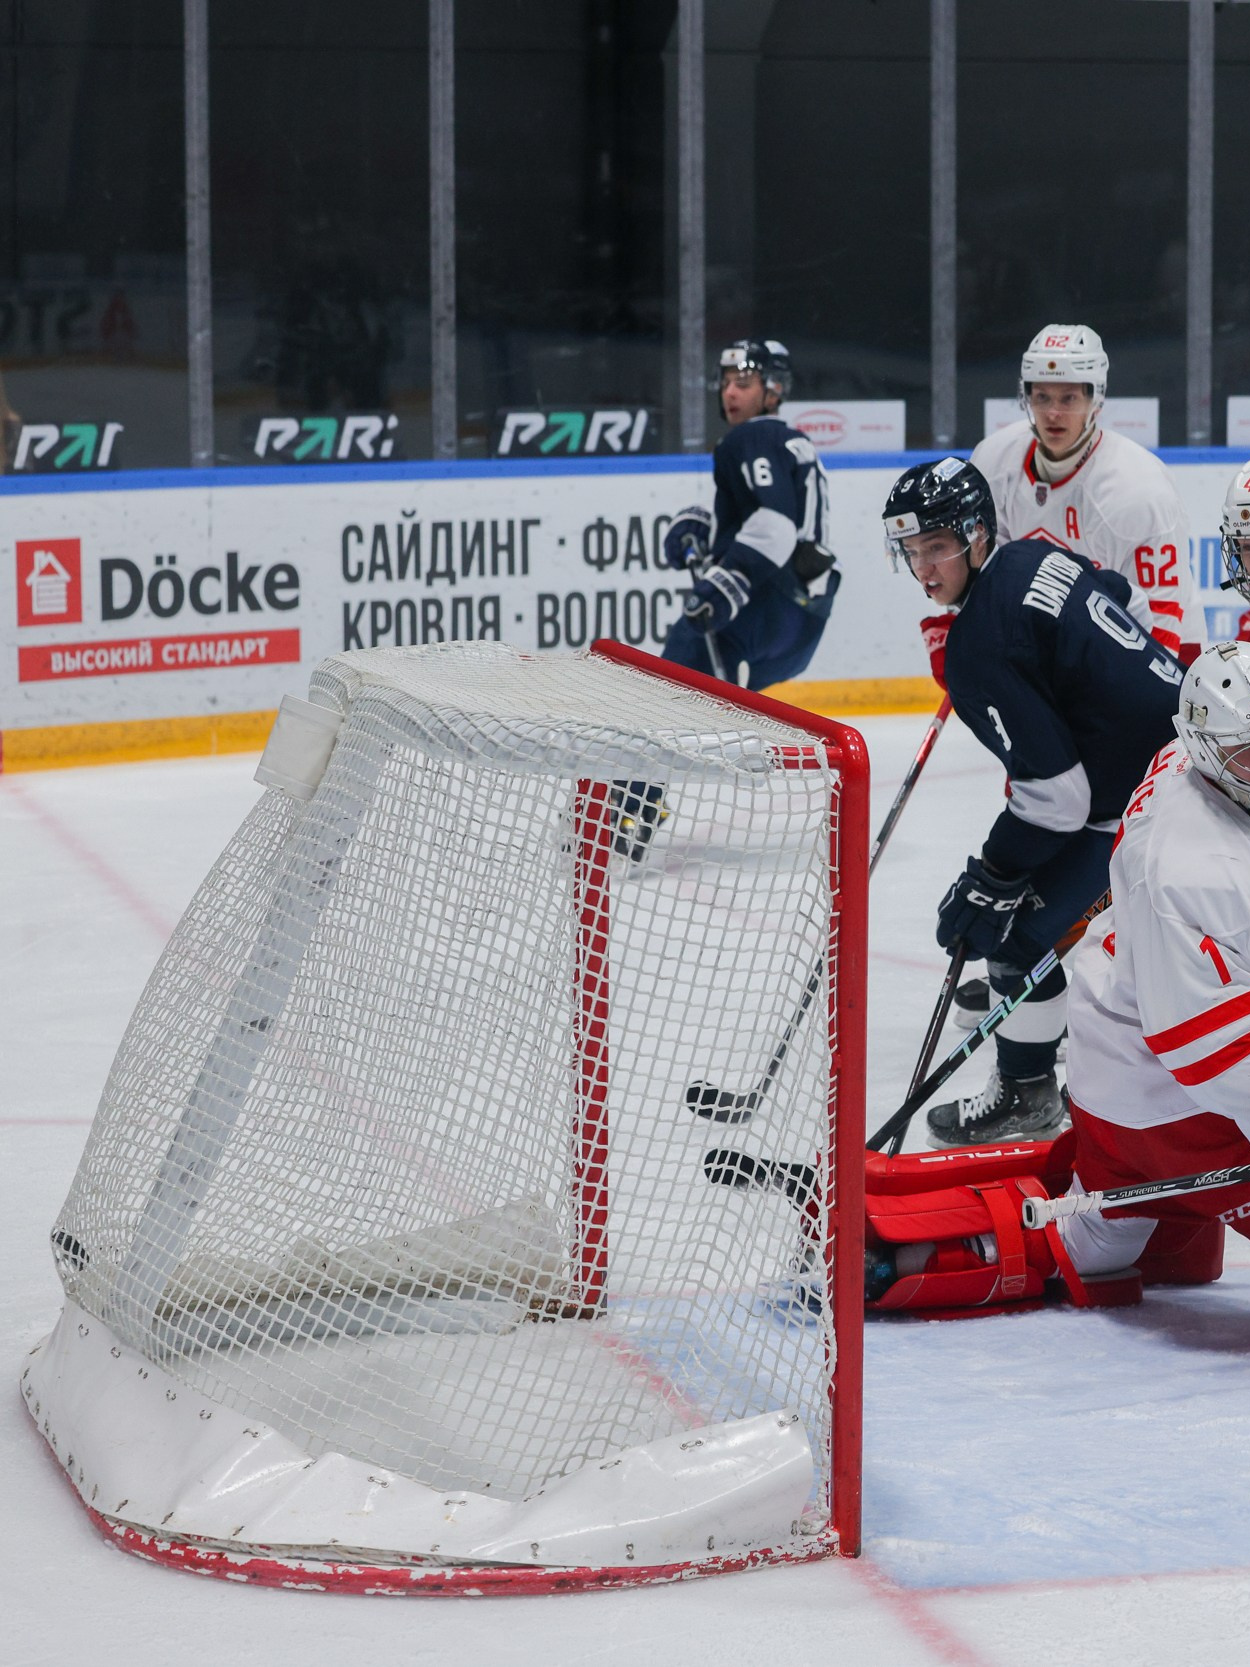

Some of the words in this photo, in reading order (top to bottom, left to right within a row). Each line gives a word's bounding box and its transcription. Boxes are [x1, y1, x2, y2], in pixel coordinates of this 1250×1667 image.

[1044, 336, 1069, 348] 62
[900, 478, 915, 493] 9
[341, 509, 541, 587] САЙДИНГ
[582, 515, 675, 573] ФАС
[1135, 544, 1179, 588] 62
[100, 551, 300, 622] Döcke
[343, 595, 501, 652] КРОВЛЯ
[51, 640, 153, 674] ВЫСОКИЙ
[161, 637, 269, 665] СТАНДАРТ
[1200, 934, 1231, 986] 1
[1118, 1184, 1162, 1200] SUPREME
[1194, 1172, 1230, 1187] MACH
